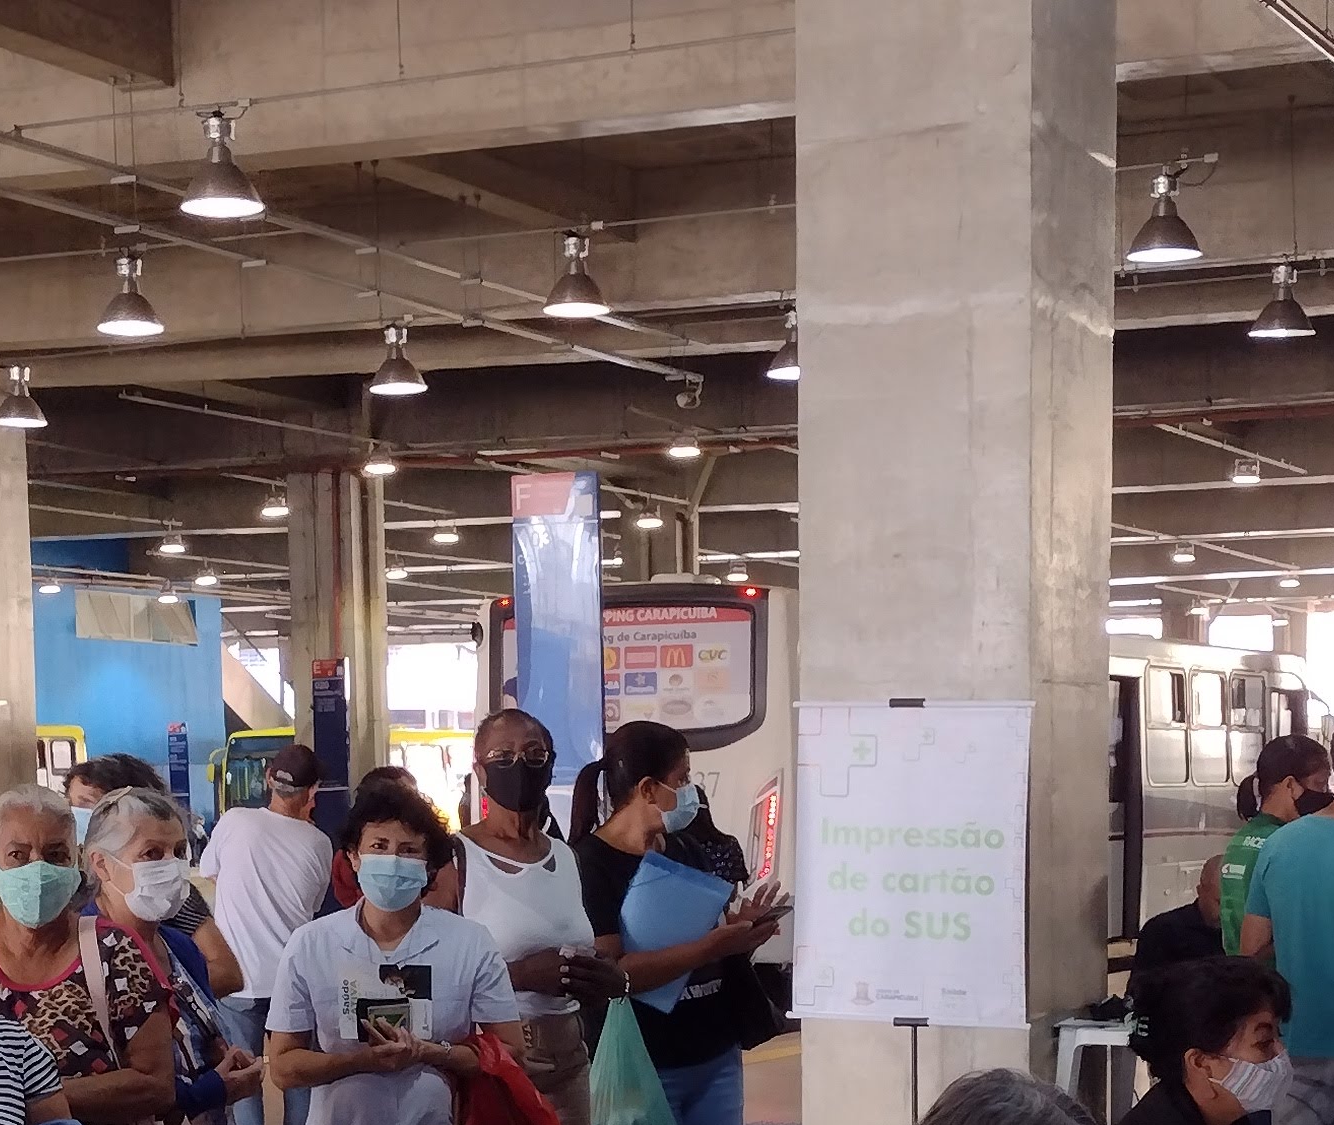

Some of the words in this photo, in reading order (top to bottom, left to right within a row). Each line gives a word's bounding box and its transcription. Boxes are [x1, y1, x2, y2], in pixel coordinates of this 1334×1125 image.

[516, 484, 531, 511] F
[617, 631, 630, 642] de
[821, 816, 1005, 855] Impressão
[827, 861, 868, 891] de
[881, 867, 995, 896] cartão
[848, 907, 890, 937] do
[904, 911, 972, 941] SUS
